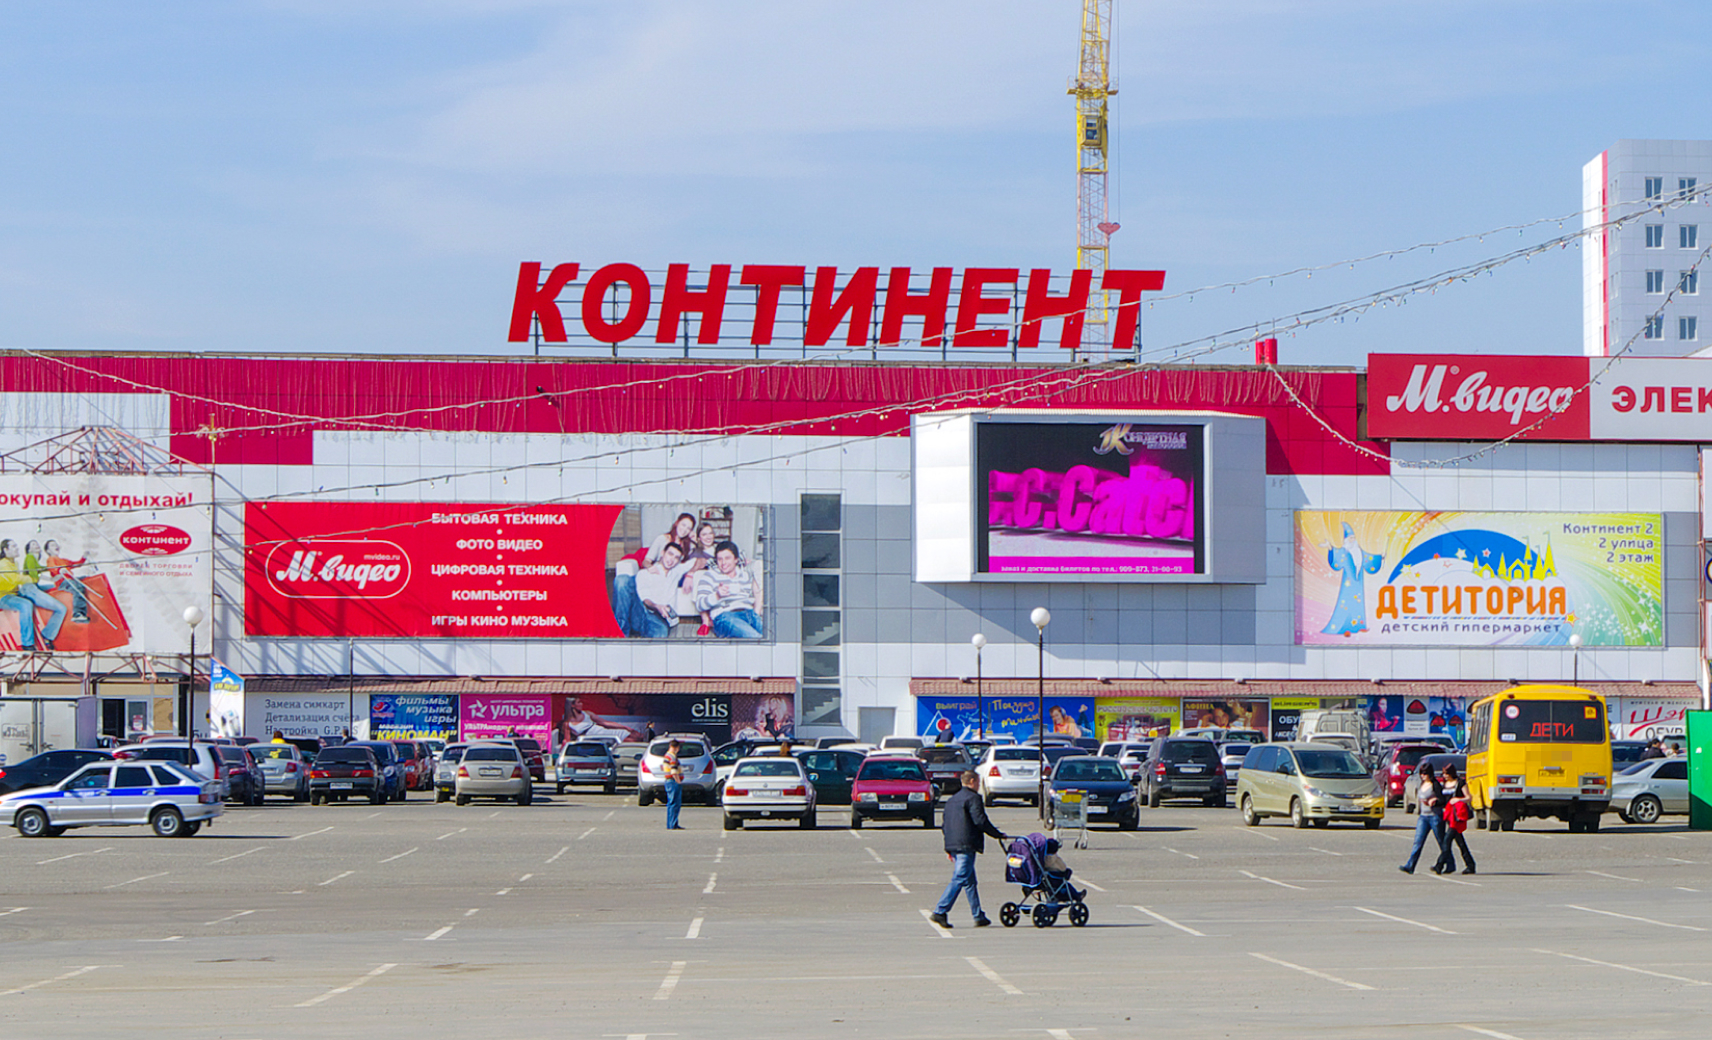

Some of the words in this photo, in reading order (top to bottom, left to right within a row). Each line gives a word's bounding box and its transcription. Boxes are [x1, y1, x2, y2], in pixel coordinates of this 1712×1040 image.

[507, 261, 1166, 349] КОНТИНЕНТ
[1385, 364, 1574, 425] М.видео
[1611, 386, 1712, 413] ЭЛЕК
[79, 494, 90, 505] и
[98, 492, 193, 509] отдыхай!
[431, 513, 500, 524] БЫТОВАЯ
[504, 513, 568, 525] ТЕХНИКА
[1563, 523, 1641, 534] Континент
[1645, 523, 1653, 534] 2
[456, 539, 495, 550] ФОТО
[497, 539, 543, 552] ВИДЕО
[1598, 537, 1607, 549] 2
[1610, 539, 1654, 551] улица
[1606, 551, 1615, 563] 2
[1618, 554, 1654, 563] этаж
[275, 550, 401, 590] М.видео
[431, 564, 505, 577] ЦИФРОВАЯ
[508, 564, 568, 576] ТЕХНИКА
[452, 590, 547, 601] КОМПЬЮТЕРЫ
[1376, 585, 1566, 619] ДЕТИТОРИЯ
[431, 615, 468, 626] ИГРЫ
[471, 616, 508, 626] КИНО
[511, 616, 568, 627] МУЗЫКА
[1381, 621, 1449, 634] детский
[1454, 623, 1561, 635] гипермаркет
[265, 699, 301, 709] Замена
[303, 701, 346, 711] симкарт
[395, 696, 449, 706] фильмы
[935, 701, 977, 711] выиграй
[406, 706, 453, 716] музыка
[490, 705, 545, 720] ультра
[691, 698, 729, 718] elis
[265, 713, 330, 723] Детализация
[424, 715, 457, 725] игры
[1529, 722, 1574, 737] ДЕТИ
